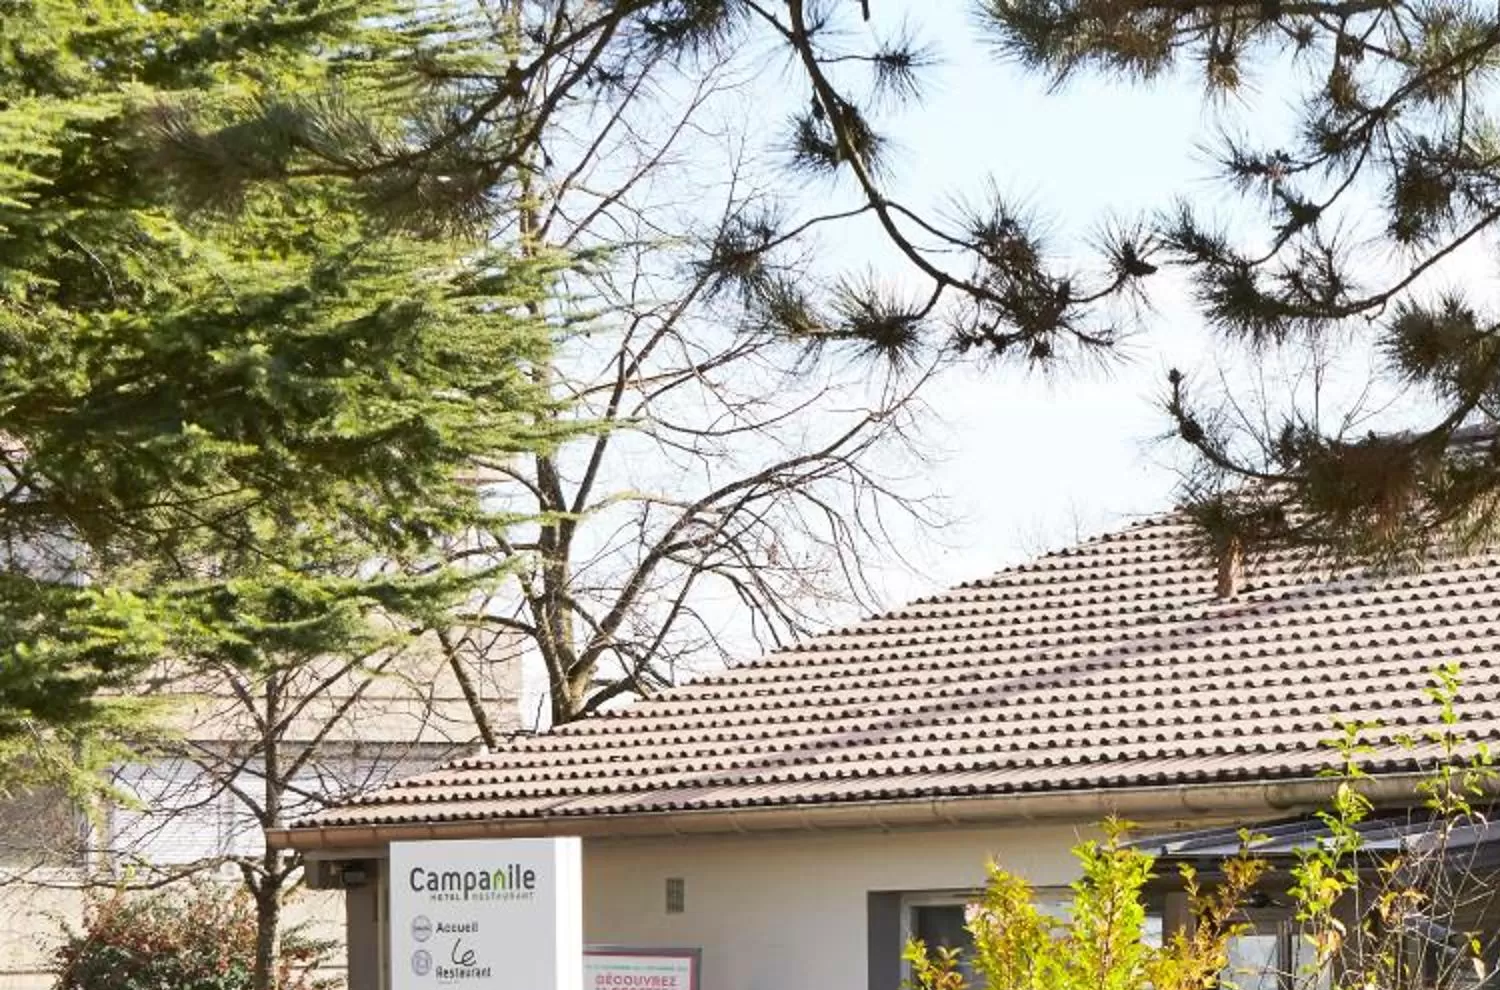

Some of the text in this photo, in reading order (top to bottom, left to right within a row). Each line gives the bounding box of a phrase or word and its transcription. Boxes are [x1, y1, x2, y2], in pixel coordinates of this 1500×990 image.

[409, 864, 536, 900] Campanile
[435, 922, 479, 933] Accueil
[451, 938, 477, 967] Le
[435, 966, 491, 978] Restaurant
[595, 972, 677, 987] DÉCOUVREZ
